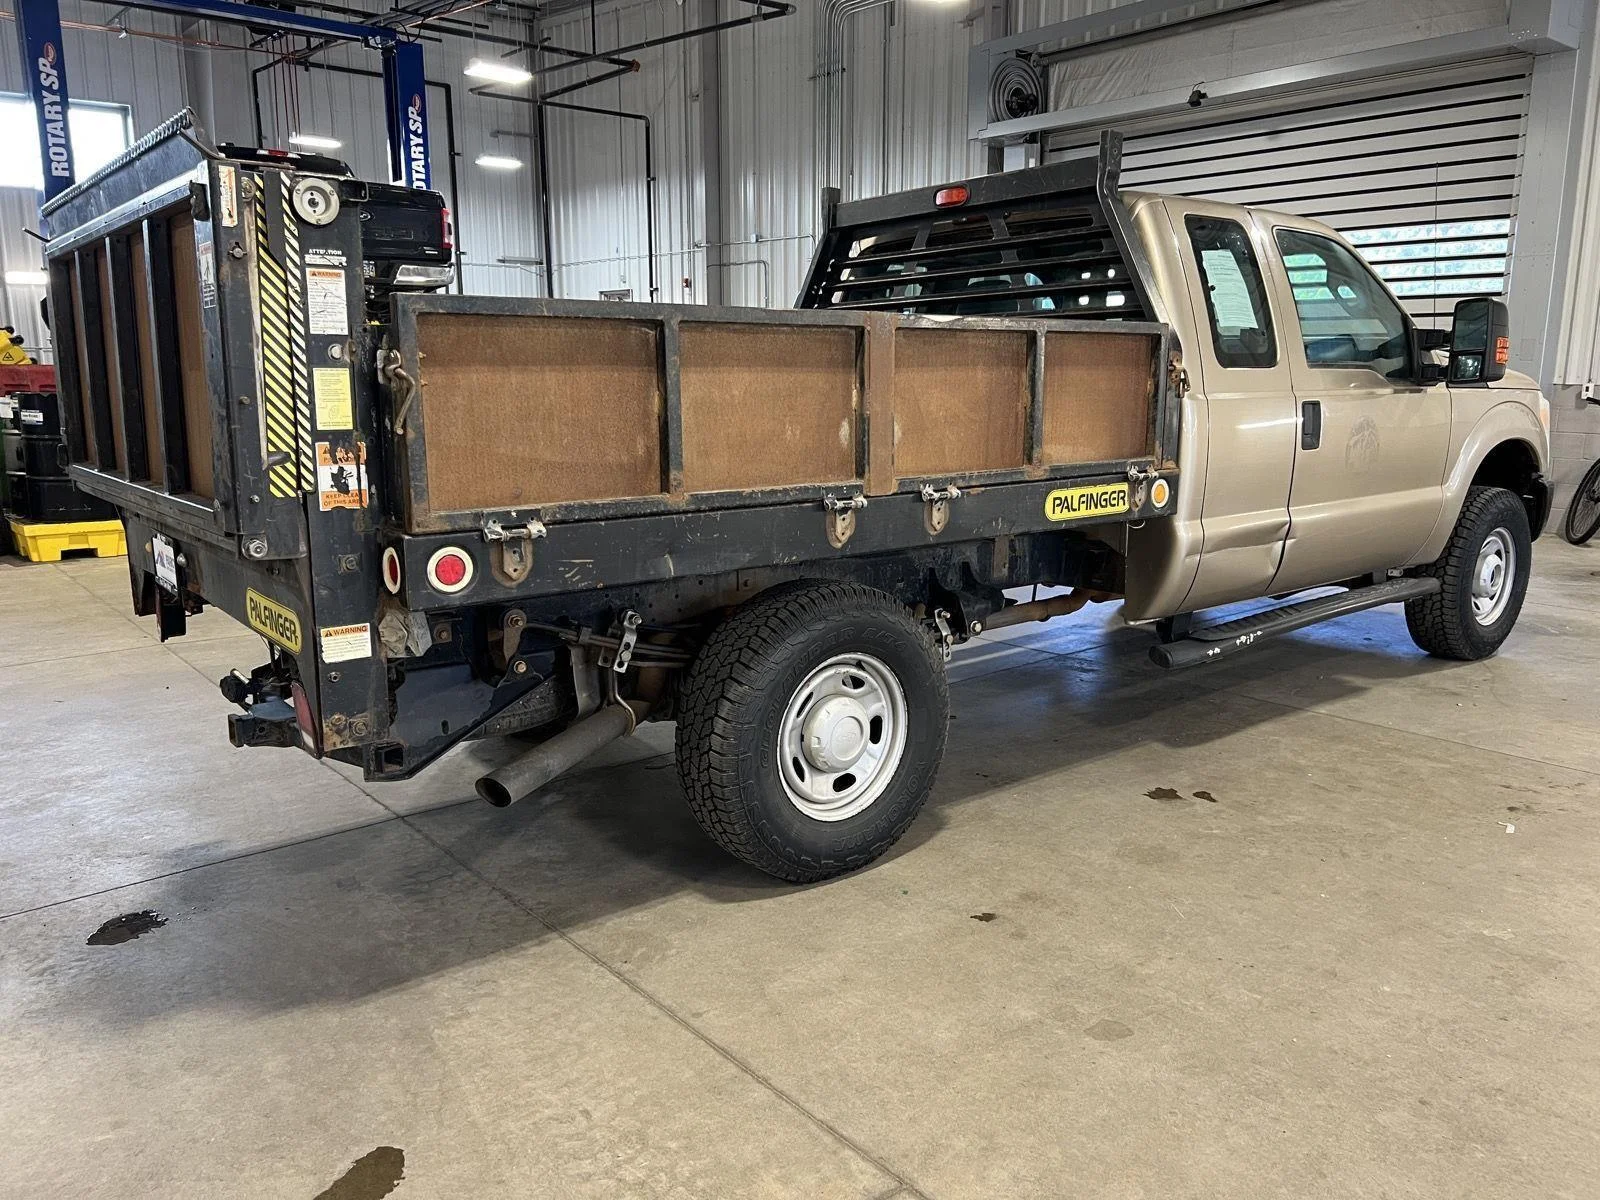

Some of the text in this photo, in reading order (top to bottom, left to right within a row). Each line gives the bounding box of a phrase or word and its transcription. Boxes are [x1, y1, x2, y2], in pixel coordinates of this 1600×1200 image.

[38, 57, 59, 90] SP
[42, 90, 70, 177] ROTARY
[408, 106, 423, 134] SP
[410, 133, 427, 190] OTARY
[1052, 489, 1126, 515] PALFINGER
[249, 596, 298, 646] PALFINGER
[333, 625, 368, 636] WARNING
